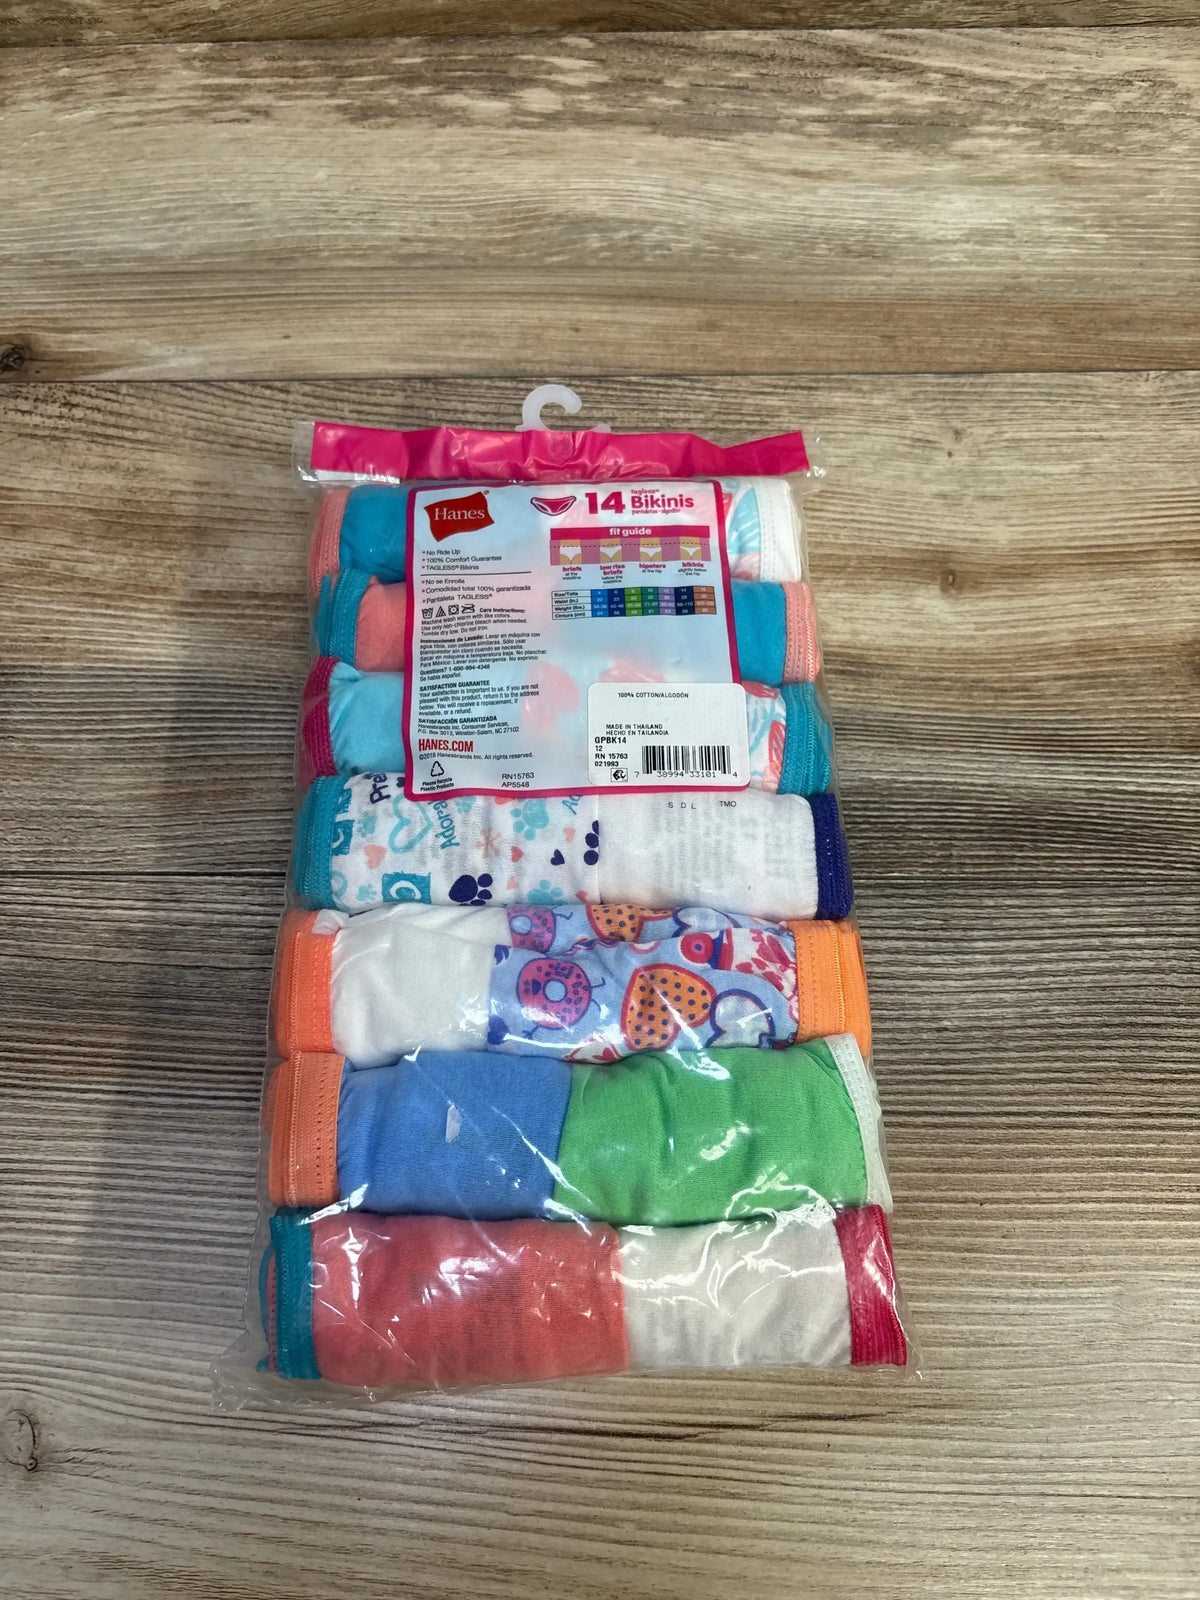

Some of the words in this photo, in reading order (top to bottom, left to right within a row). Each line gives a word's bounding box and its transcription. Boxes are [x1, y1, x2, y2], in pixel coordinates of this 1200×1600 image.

[584, 491, 626, 515] 14
[630, 494, 695, 509] Bikinis
[434, 507, 486, 520] Hanes
[609, 527, 620, 536] fit
[621, 527, 652, 537] guide
[420, 682, 457, 692] SATISFACTION
[457, 679, 490, 688] GUARANTEE
[635, 691, 689, 699] COTTON/ALGODÓN
[418, 738, 474, 752] HANES.COM
[594, 736, 627, 744] GPBK14
[501, 771, 535, 780] RN15763
[501, 780, 530, 788] AP5548
[718, 800, 737, 808] TMO
